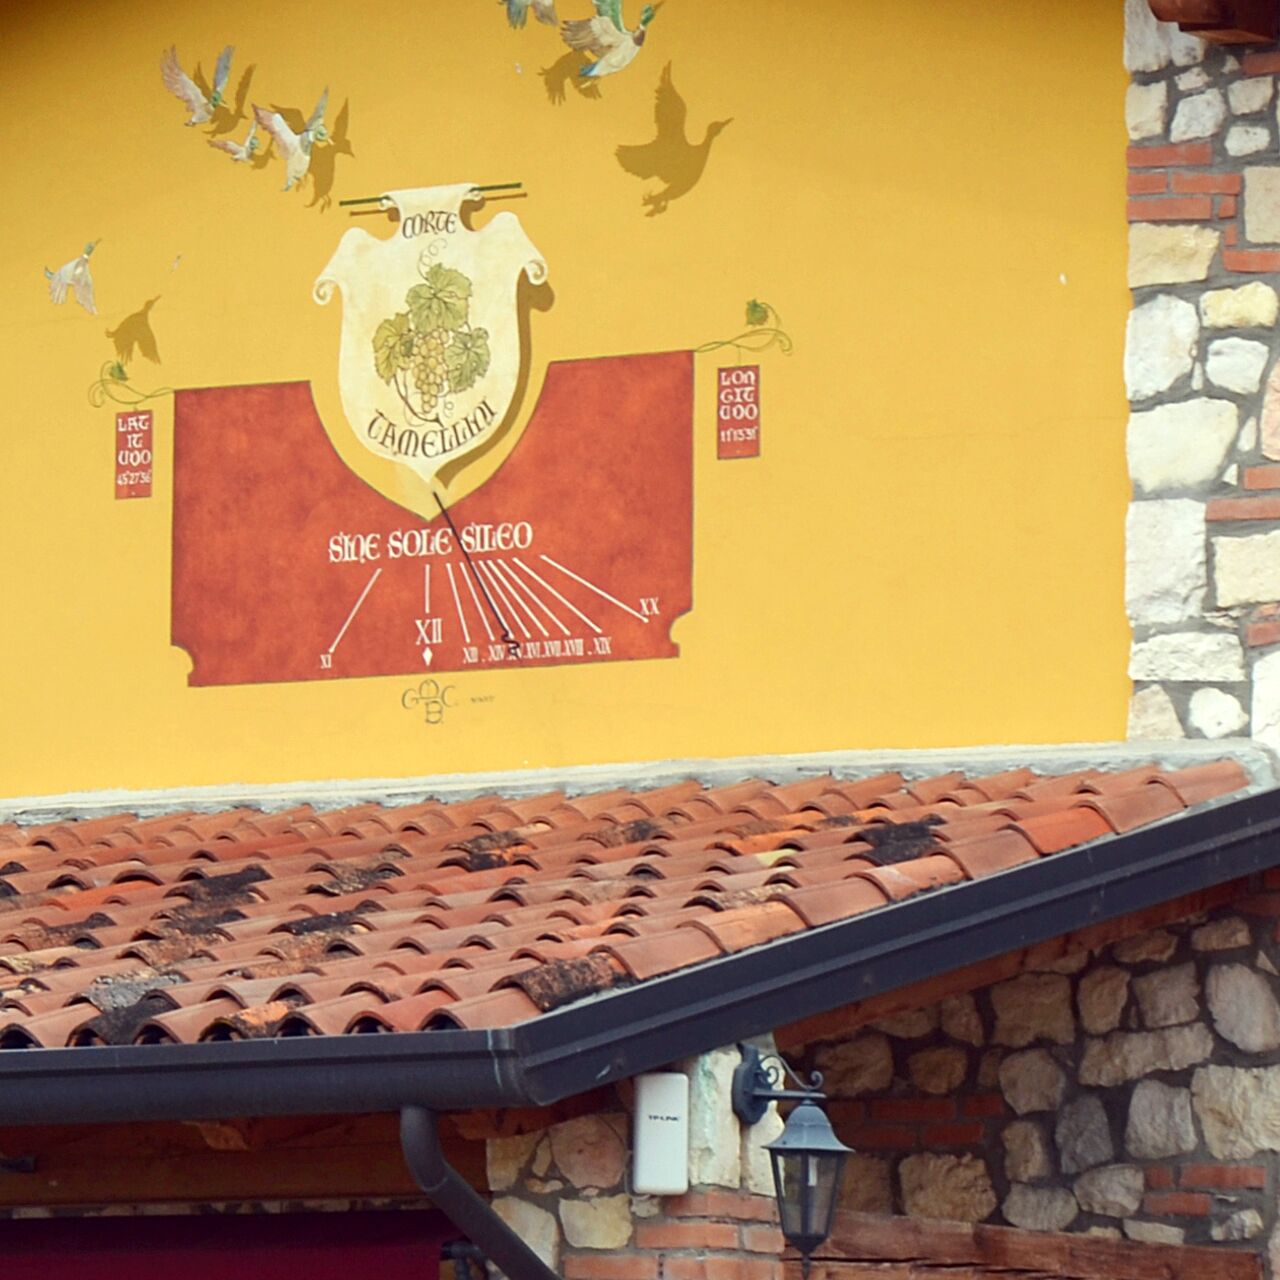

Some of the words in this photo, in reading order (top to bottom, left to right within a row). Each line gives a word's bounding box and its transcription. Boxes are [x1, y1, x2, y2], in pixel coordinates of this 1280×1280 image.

[402, 210, 457, 239] CORTE
[367, 397, 498, 458] TAMELLINI
[328, 531, 381, 564] SINE
[387, 527, 454, 559] SOLE
[460, 521, 534, 554] SILEO
[639, 597, 661, 616] XX
[415, 618, 443, 646] XII
